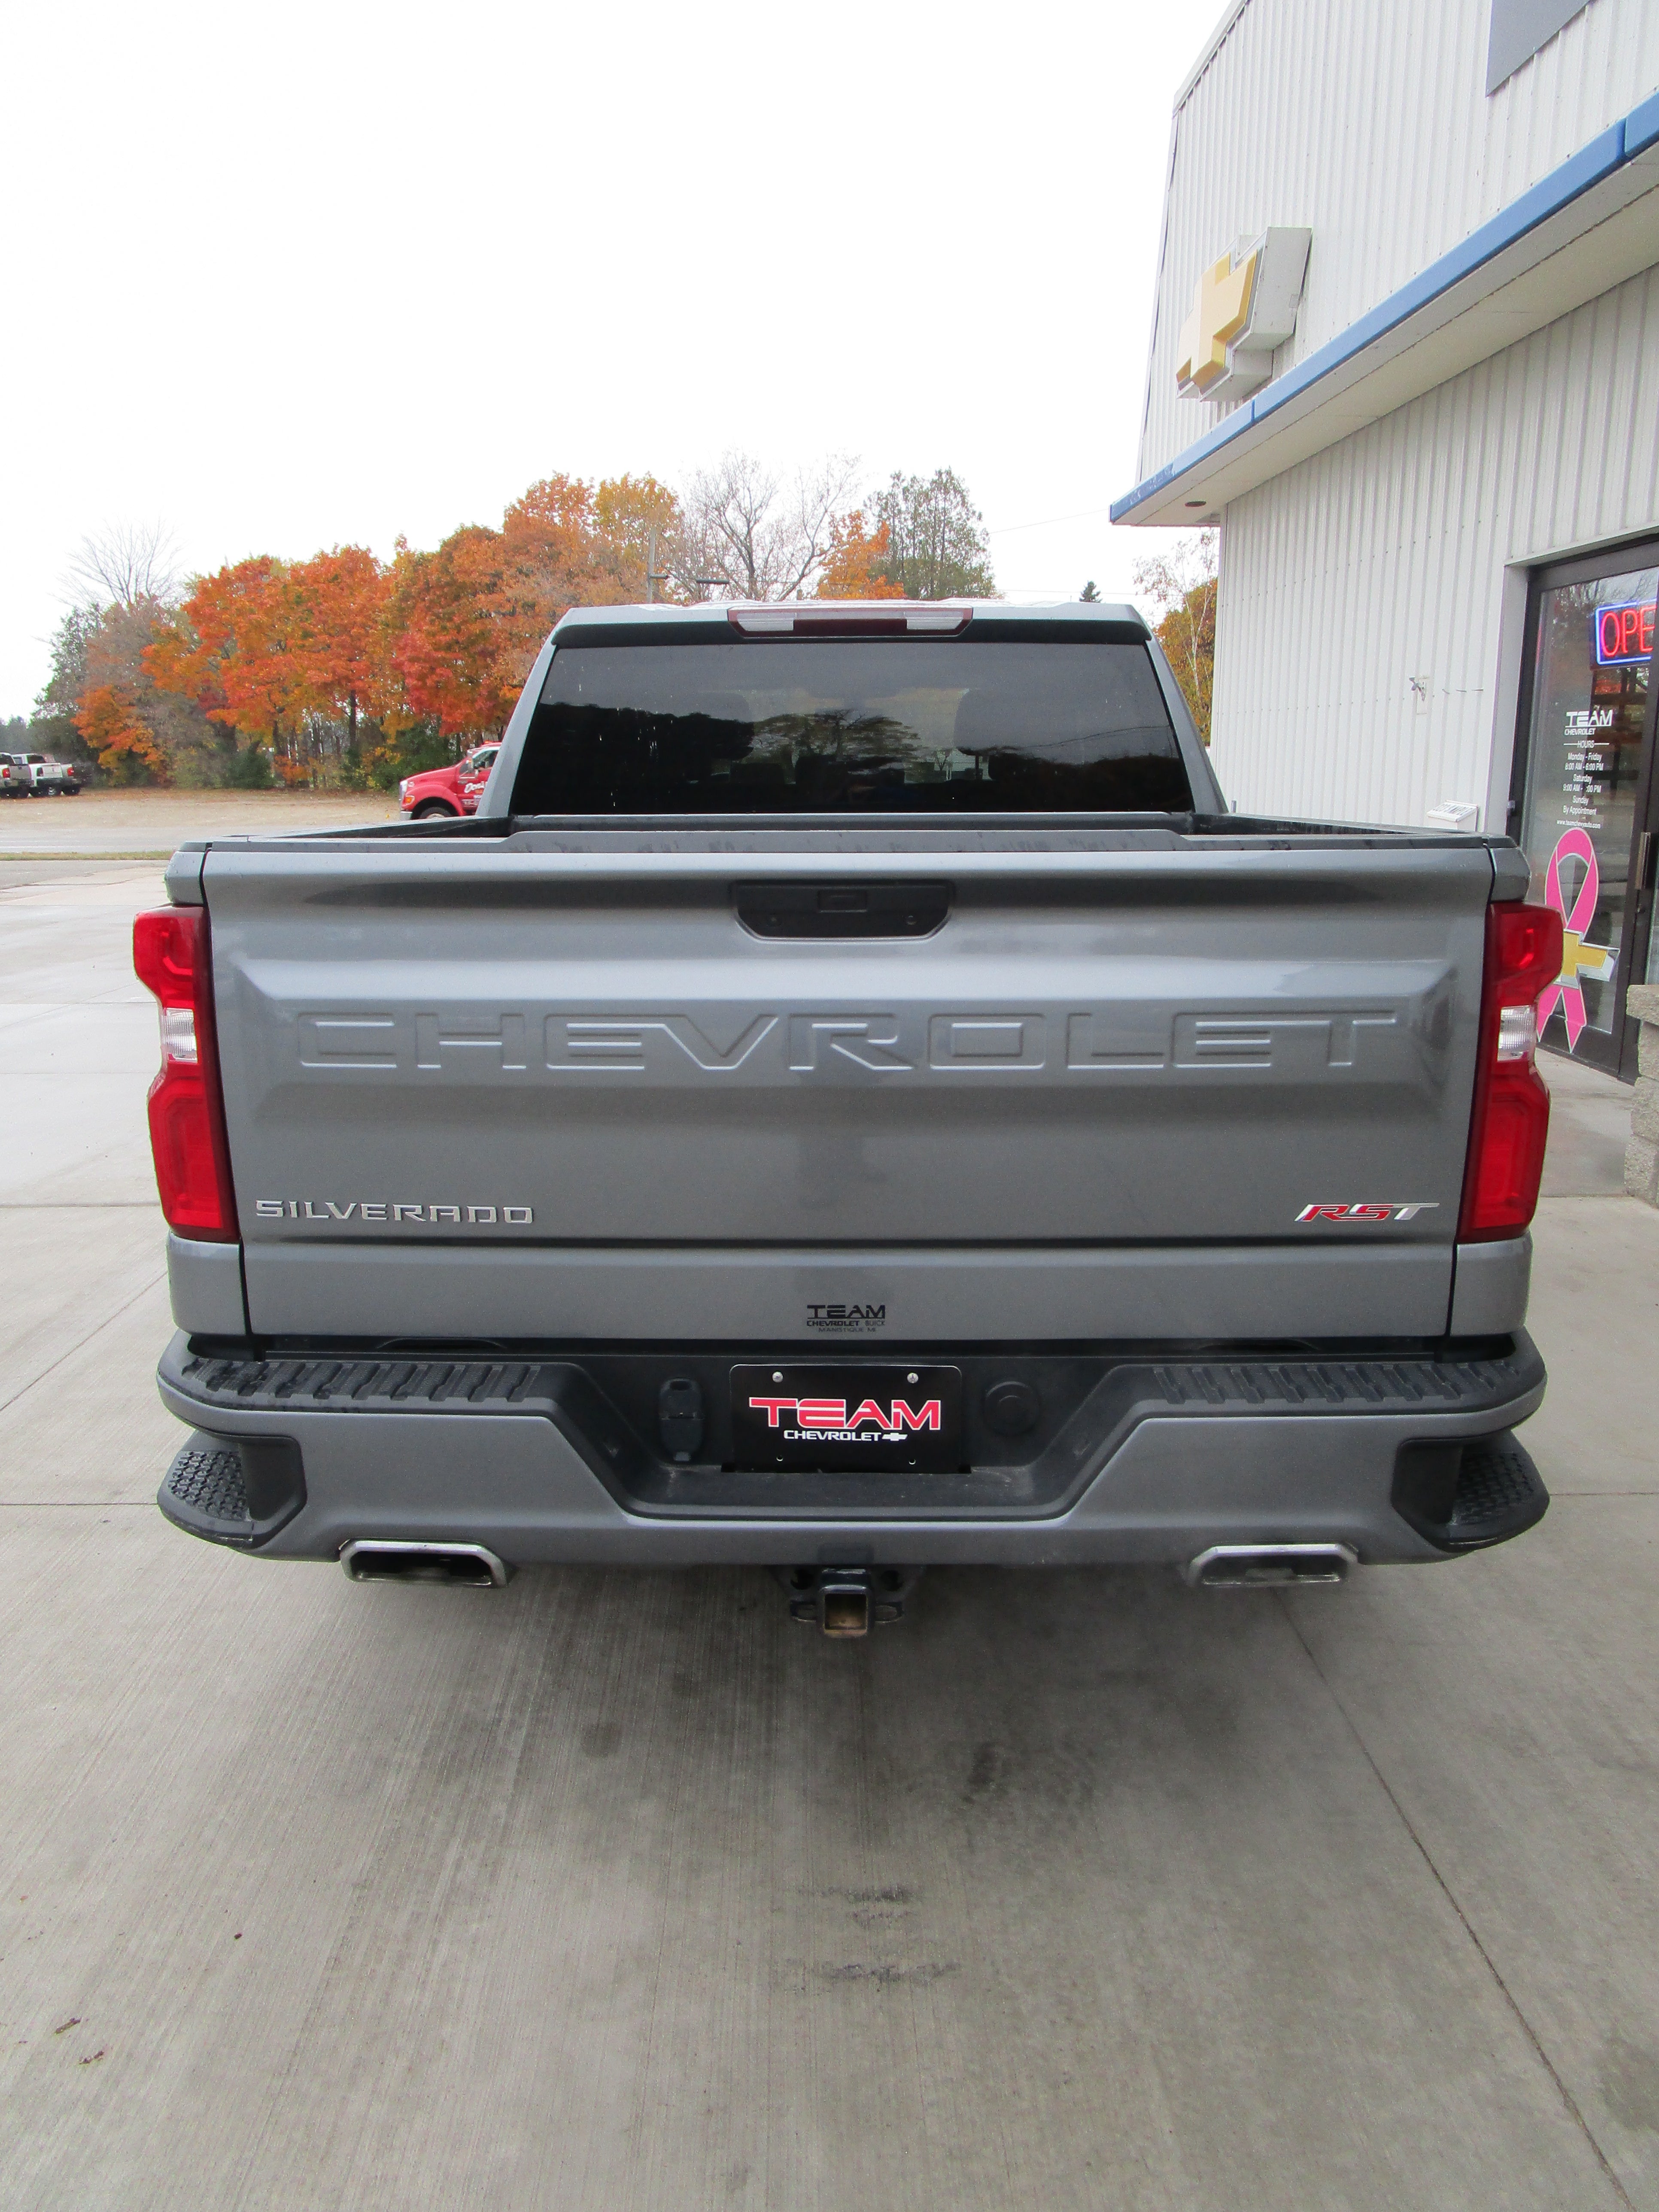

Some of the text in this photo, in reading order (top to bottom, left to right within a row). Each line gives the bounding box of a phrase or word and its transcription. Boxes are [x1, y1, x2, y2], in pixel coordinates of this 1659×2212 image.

[1601, 605, 1657, 657] OPE
[1566, 709, 1613, 726] TEAM
[1577, 740, 1595, 748] HOURS
[1568, 752, 1584, 762] Monday
[1588, 752, 1602, 763] Friday
[1565, 762, 1575, 770] 8:00
[1574, 762, 1583, 770] AM
[1585, 763, 1595, 771] 6:00
[1596, 763, 1604, 771] PM
[1573, 774, 1593, 784] Saturday
[1593, 785, 1601, 793] PM
[1572, 794, 1589, 805] Sunday
[1563, 805, 1597, 815] By Appointment
[297, 1012, 1400, 1071] CHEVROLET
[255, 1200, 534, 1224] SILVERADO
[1294, 1203, 1440, 1221] RST
[807, 1305, 885, 1319] TEAM
[749, 1397, 941, 1431] TEAM
[783, 1430, 881, 1442] CHEVROLET
